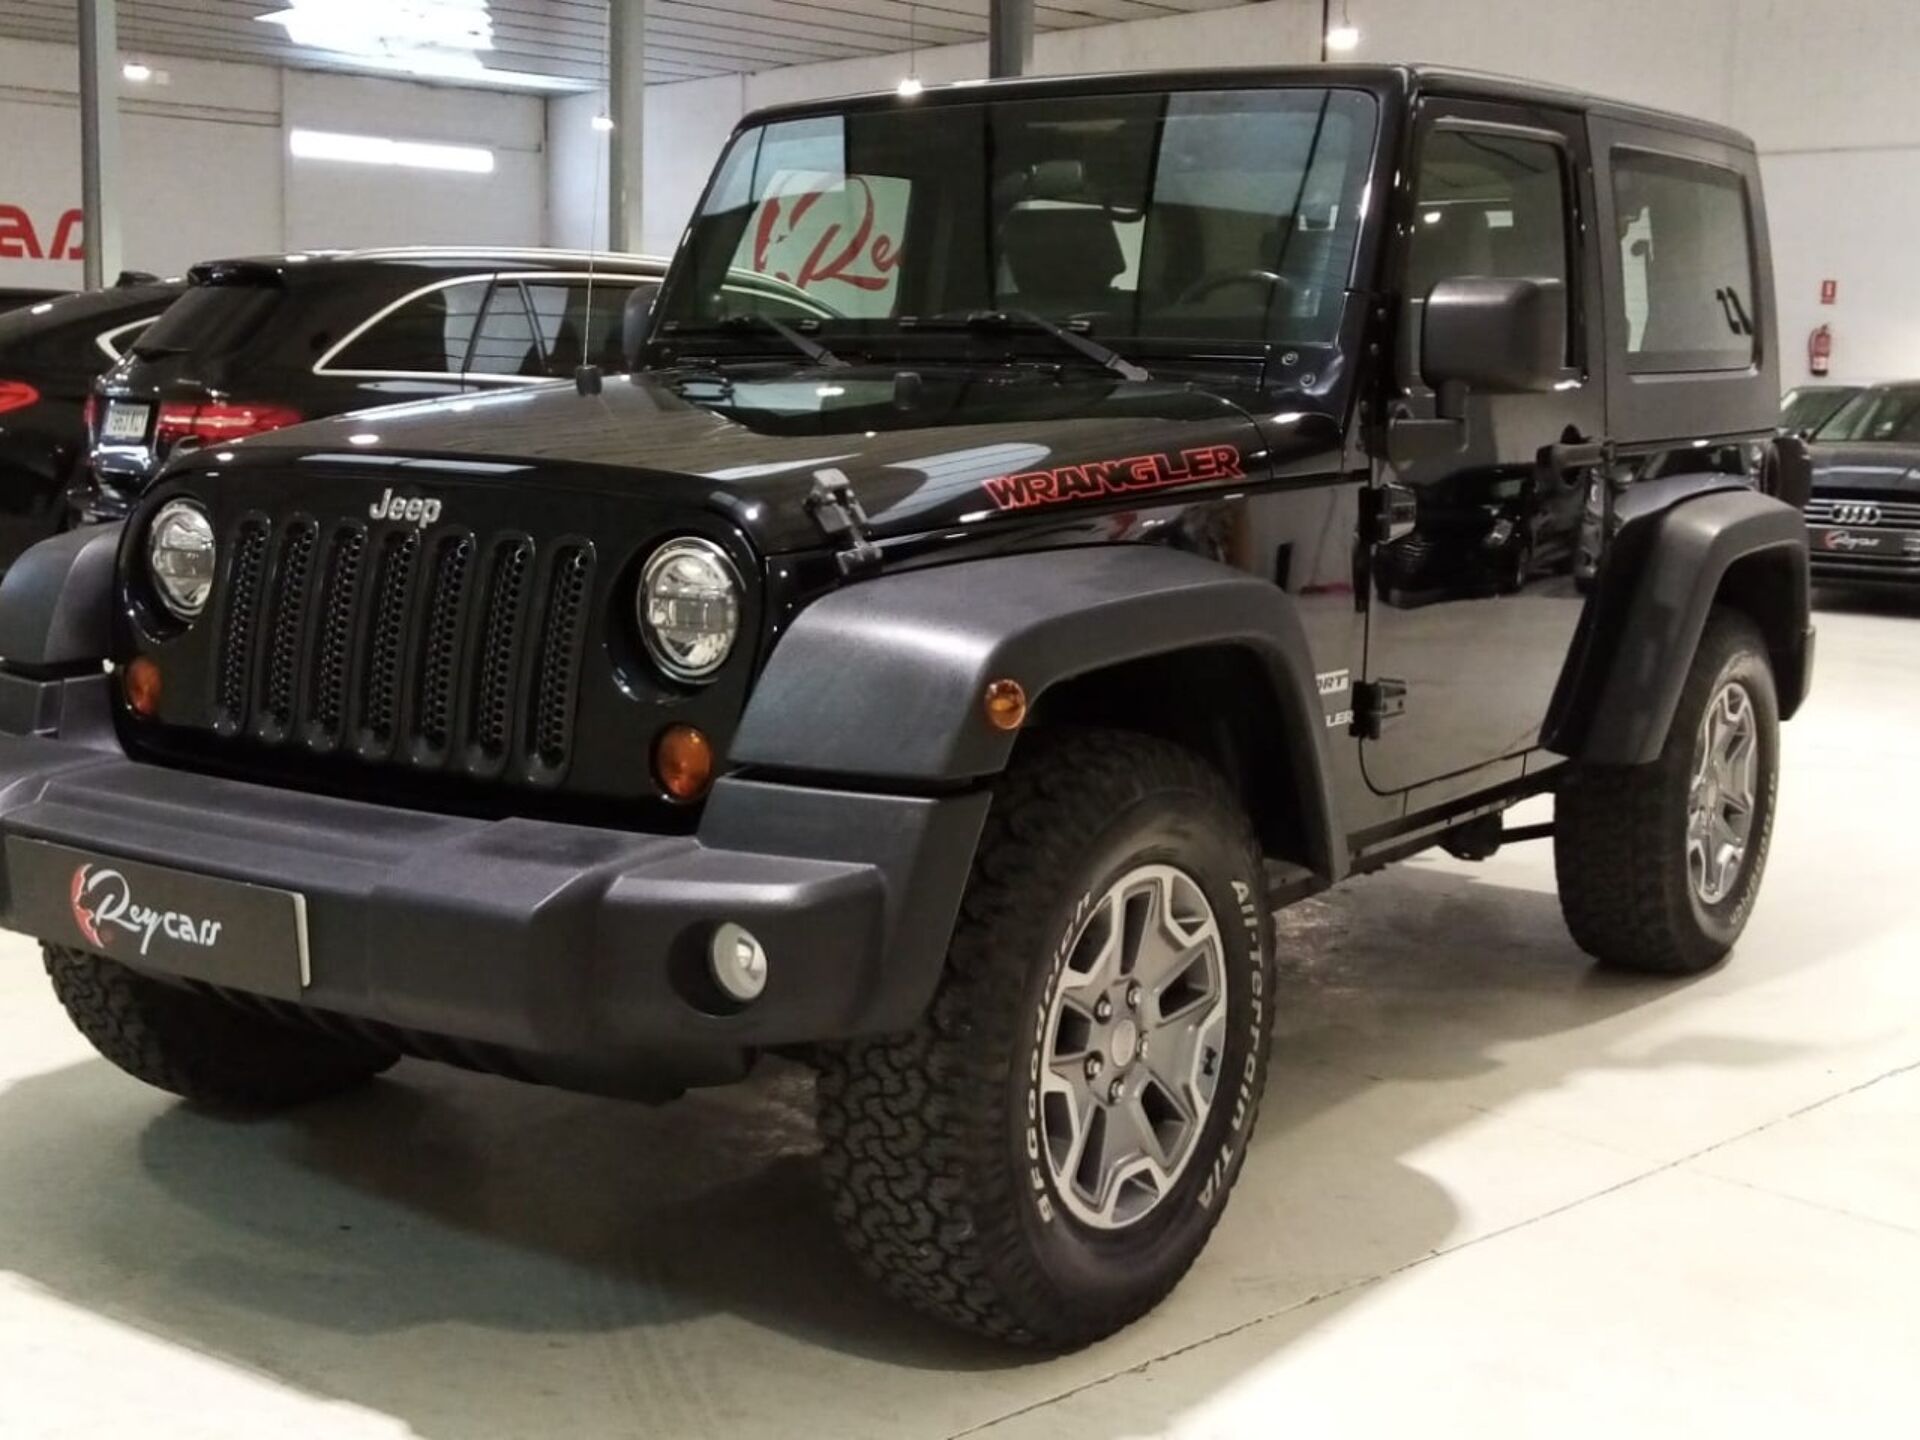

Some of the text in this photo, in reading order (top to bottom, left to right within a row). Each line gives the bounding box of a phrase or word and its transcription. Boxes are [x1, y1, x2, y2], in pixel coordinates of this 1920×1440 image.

[369, 487, 442, 529] Jeep
[981, 444, 1247, 510] WRANGLER
[88, 869, 222, 955] Reycars
